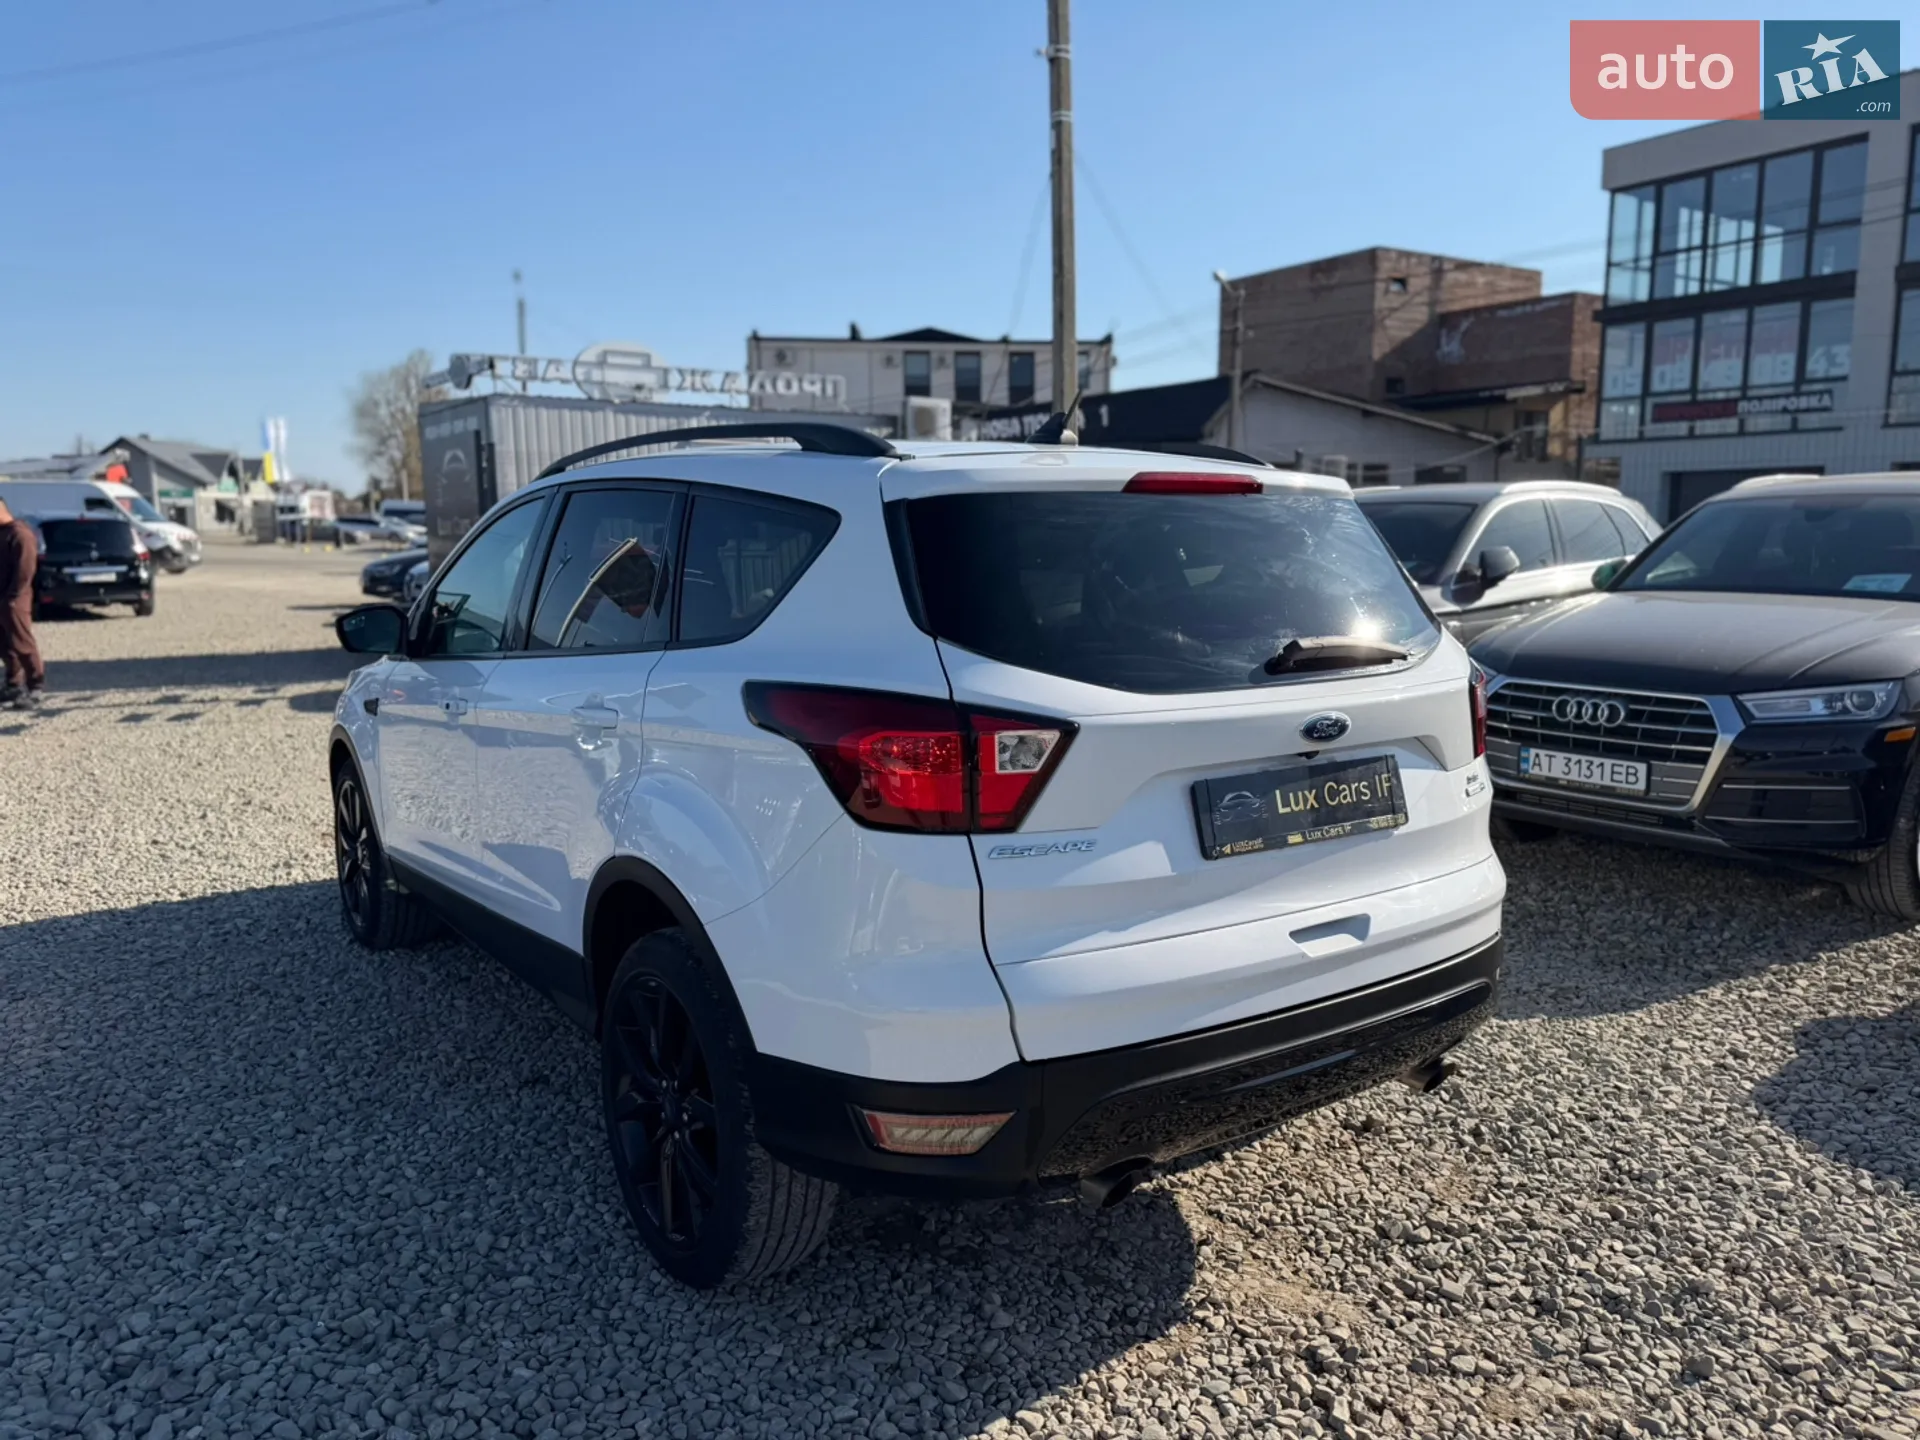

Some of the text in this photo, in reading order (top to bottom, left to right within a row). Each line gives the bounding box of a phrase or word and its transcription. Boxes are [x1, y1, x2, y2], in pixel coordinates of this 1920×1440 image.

[1313, 719, 1341, 738] Ford
[1531, 752, 1639, 786] AT 3131 EB
[1275, 772, 1392, 814] Lux Cars IF
[1306, 829, 1322, 841] Lux
[1323, 826, 1344, 838] Cars
[988, 839, 1097, 859] ESCAPE
